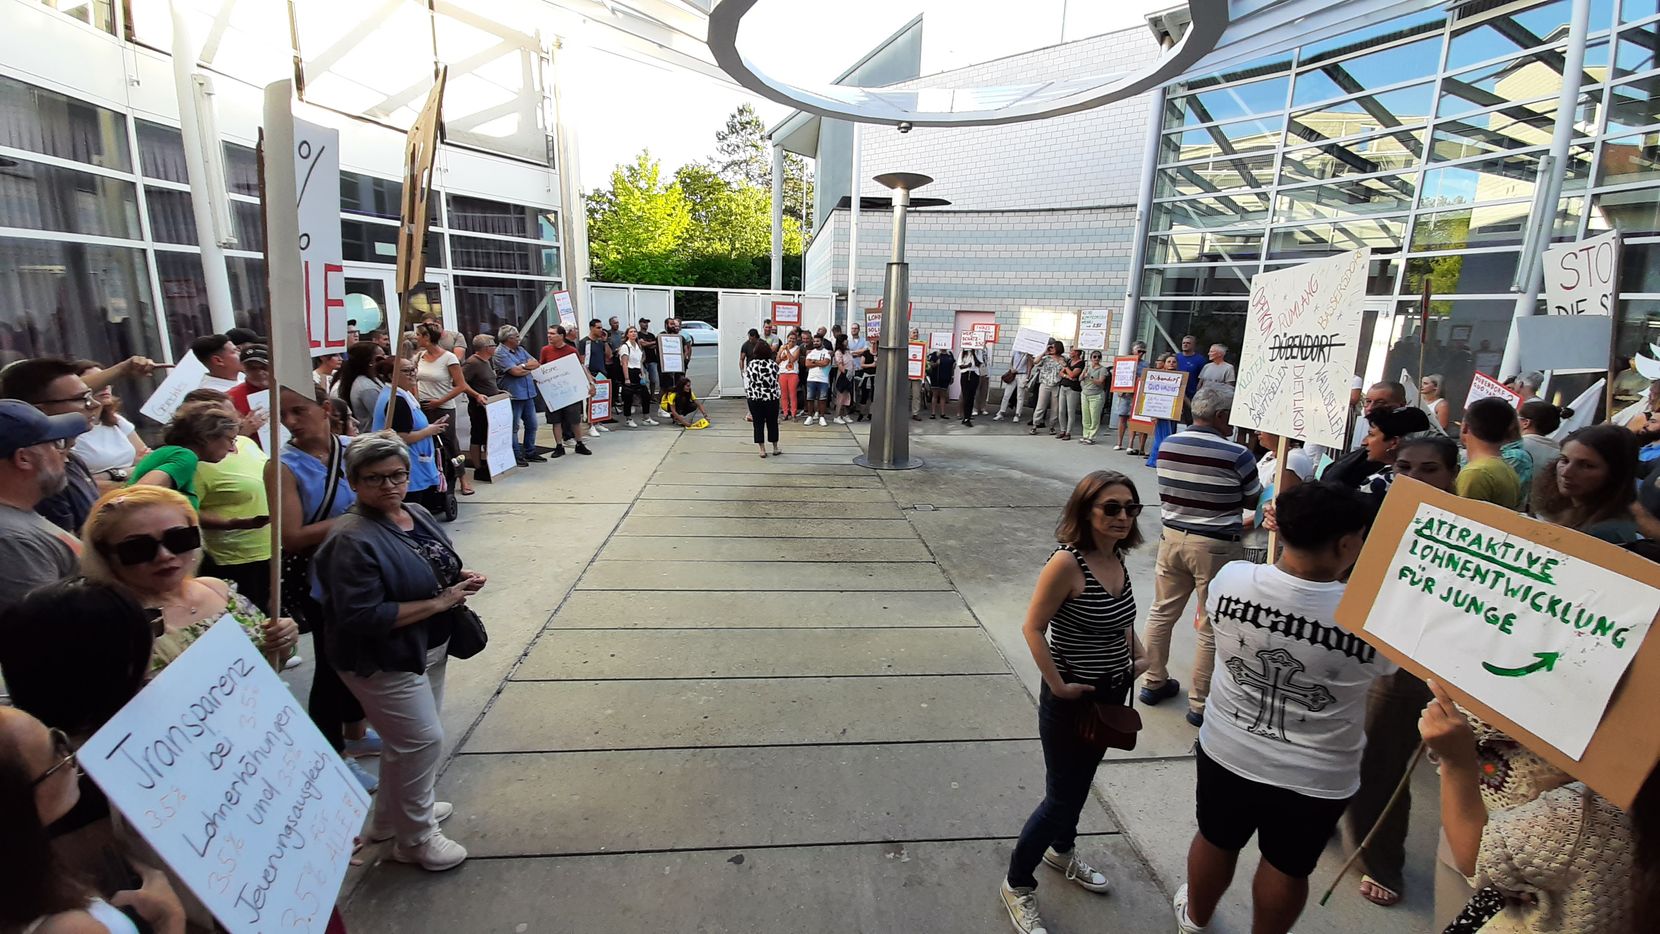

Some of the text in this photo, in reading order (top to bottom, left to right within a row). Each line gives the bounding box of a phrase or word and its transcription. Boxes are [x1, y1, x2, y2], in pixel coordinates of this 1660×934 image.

[1560, 235, 1616, 291] STO
[304, 260, 346, 347] LE
[1600, 293, 1613, 315] S
[1268, 332, 1346, 363] DÜBENDORF
[1292, 364, 1307, 438] DIETLIKON
[1420, 516, 1560, 576] ATTRAKTIVE
[1398, 563, 1518, 635] FÜR JUNGE
[1408, 539, 1633, 650] LOHNENTWICKLUNG
[105, 656, 256, 790] Transparenz
[246, 776, 281, 826] und
